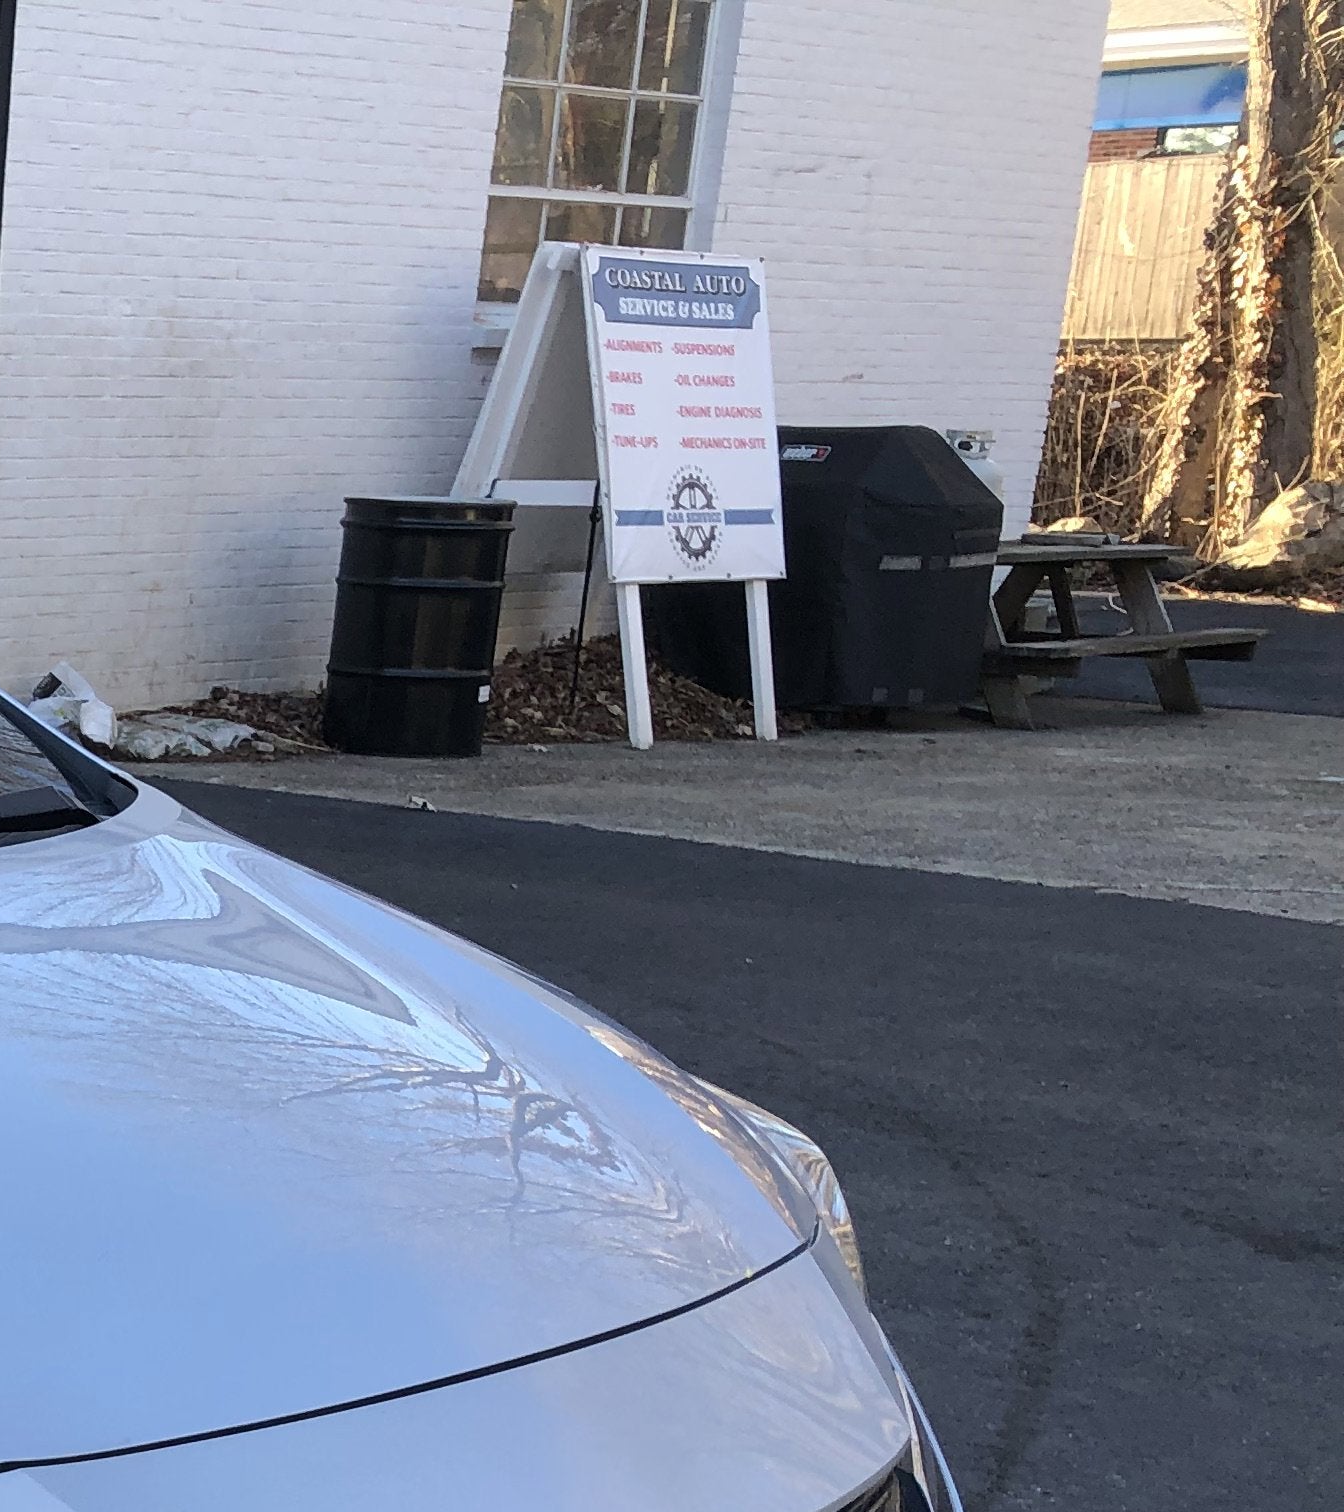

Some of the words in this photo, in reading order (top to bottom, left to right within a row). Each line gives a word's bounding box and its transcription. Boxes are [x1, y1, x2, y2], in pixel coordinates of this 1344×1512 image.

[605, 267, 686, 292] COASTAL
[693, 274, 746, 297] AUTO
[619, 297, 676, 317] SERVICE
[678, 301, 690, 318] &
[692, 301, 734, 320] SALES
[693, 375, 735, 387] CHANGES
[715, 406, 762, 418] DIAGNOSIS
[734, 438, 766, 449] ON-SITE
